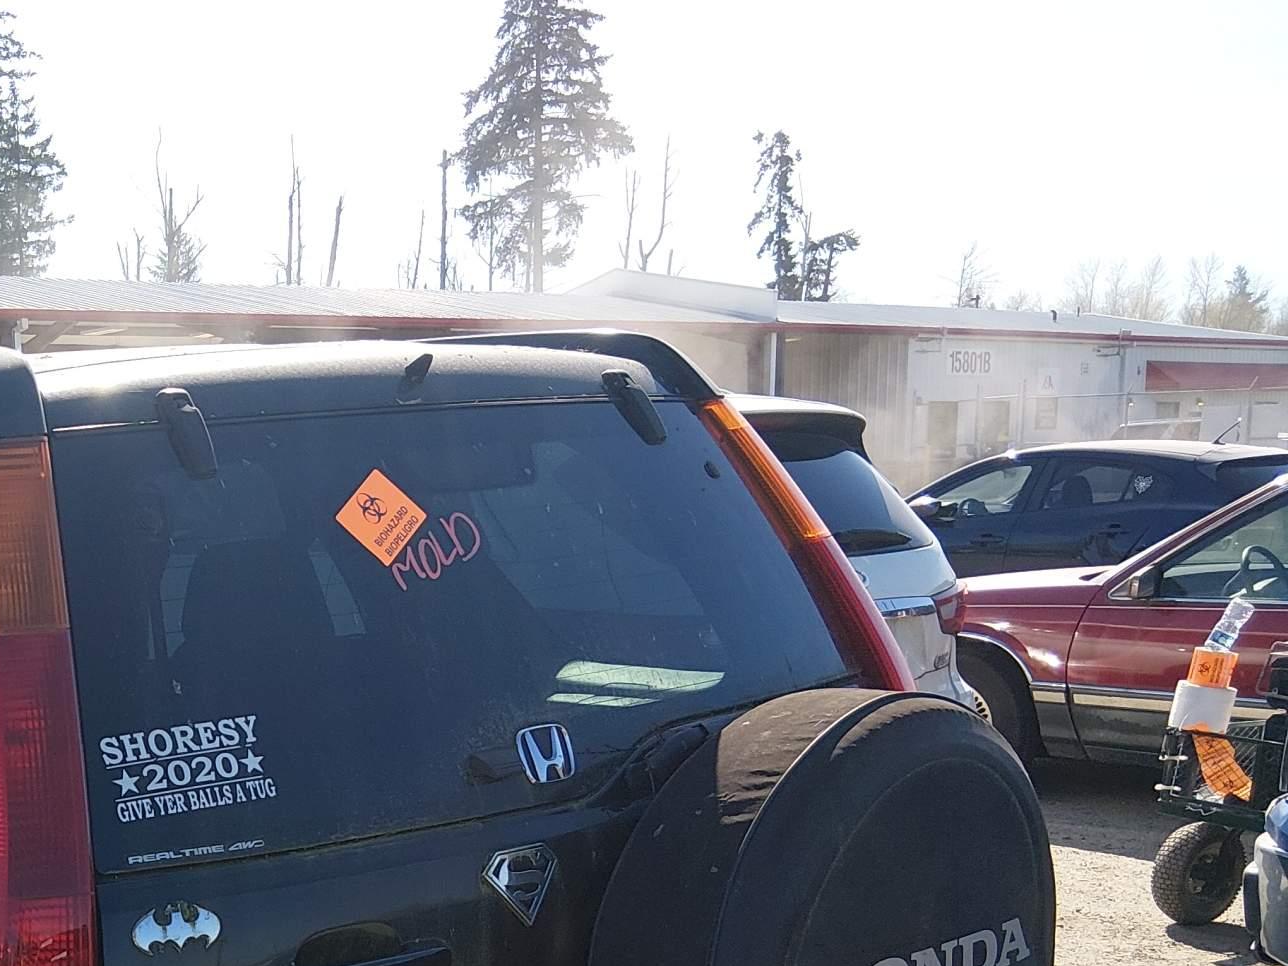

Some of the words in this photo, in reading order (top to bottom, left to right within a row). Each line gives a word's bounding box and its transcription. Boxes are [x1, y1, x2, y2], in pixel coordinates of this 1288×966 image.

[949, 350, 991, 374] 15801B
[374, 505, 409, 547] BIOHAZARD
[384, 515, 419, 557] BIOPELIGRO
[392, 512, 481, 591] MOLD
[99, 715, 257, 766] SHORESY
[142, 752, 239, 791] 2020
[116, 798, 155, 823] GIVE
[154, 794, 188, 816] YER
[187, 785, 234, 811] BALLS
[234, 784, 248, 803] A
[246, 778, 277, 801] TUG
[128, 844, 225, 865] REALTIME
